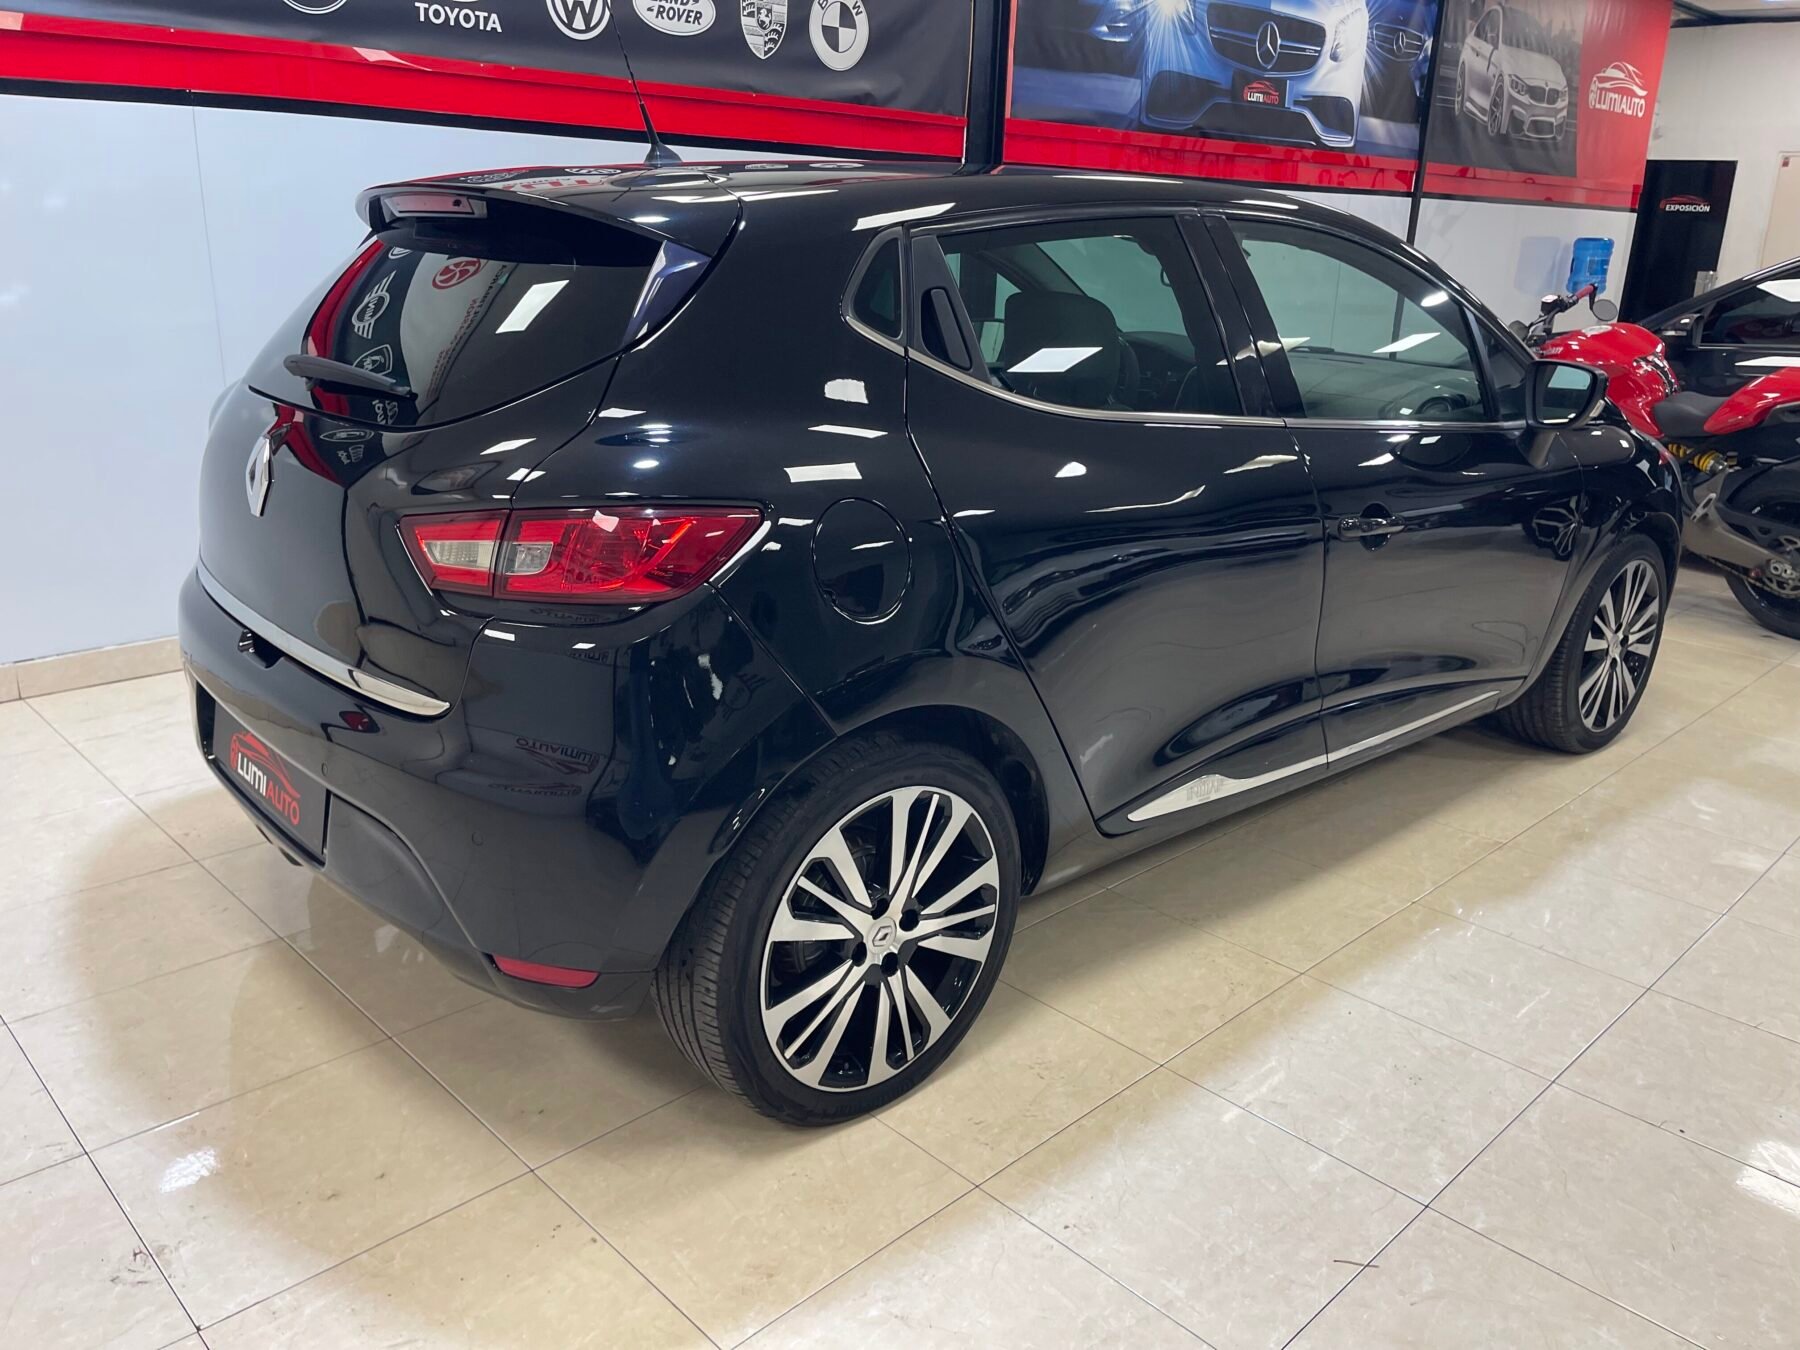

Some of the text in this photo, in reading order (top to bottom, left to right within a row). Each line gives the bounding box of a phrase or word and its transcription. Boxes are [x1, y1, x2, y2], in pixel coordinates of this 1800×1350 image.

[415, 2, 502, 33] TOYOTA
[655, 4, 703, 26] ROVER
[1595, 90, 1646, 118] LUMIAUTO
[1665, 203, 1711, 212] EXPOSICIÓN
[237, 752, 300, 825] LUMIAUTO
